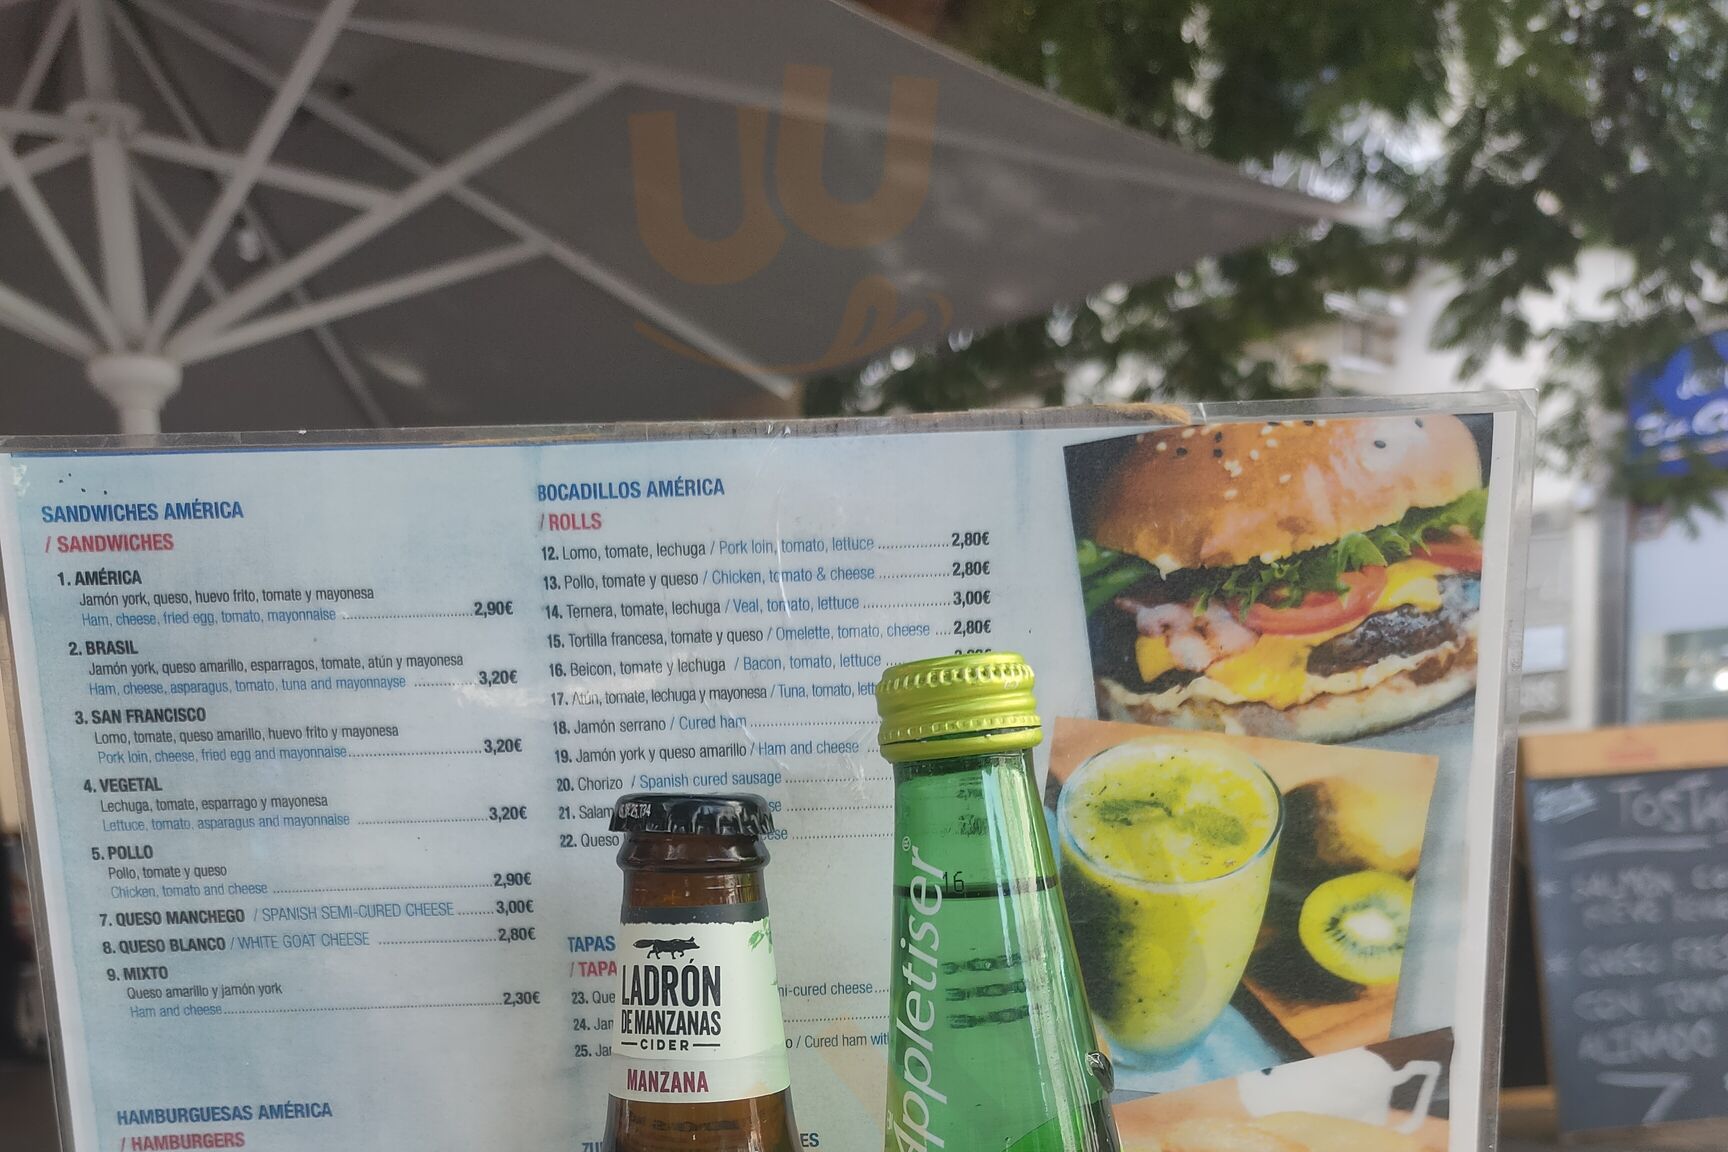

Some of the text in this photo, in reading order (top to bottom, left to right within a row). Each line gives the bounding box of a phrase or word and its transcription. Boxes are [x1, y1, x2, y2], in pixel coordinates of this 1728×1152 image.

[538, 476, 724, 502] BOCADILLOS AMÉRICA
[41, 499, 244, 523] SANDWICHES AMÉRICA
[549, 513, 602, 531] ROLLS
[57, 533, 174, 552] SANDWICHES
[542, 532, 990, 560] 12. Lomo, tomate, lechuga Pork loin, tomato, lettuce 2,80€
[75, 568, 142, 585] AMÉRICA
[544, 561, 990, 590] 13. Pollo, tomate queso Chicken, tomato cheese 2,80€
[80, 588, 374, 608] Jamón york, queso, huevo frito, tomate mayonesa
[546, 591, 991, 619] 14. Ternera, 3,00€
[474, 601, 513, 618] 2,90€
[548, 620, 991, 648] 15. Tortilla francesa, tomate queso Omelette, tomato, cheese 2,80€
[85, 641, 138, 655] BRASIL
[89, 683, 120, 696] Ham,
[123, 682, 167, 695] cheese,
[171, 682, 232, 695] asparagus,
[235, 680, 277, 692] tomato,
[282, 680, 307, 690] tuna
[311, 677, 332, 689] and
[479, 670, 518, 687] 3,20€
[551, 684, 808, 705] 17. Tuna,
[91, 710, 121, 724] SAN
[126, 707, 206, 723] FRANCISCO
[554, 715, 747, 734] 18. Jamón serrano Cured ham
[484, 739, 522, 755] 3,20€
[100, 778, 162, 792] VEGETAL
[557, 772, 781, 791] 20. Chorizo Spanish cured sausage
[489, 806, 527, 823] 3,20€
[559, 807, 575, 820] 21.
[579, 805, 613, 819] Salam
[560, 834, 619, 847] 22. Queso
[108, 845, 153, 860] POLLO
[494, 872, 531, 889] 2,90€
[116, 911, 162, 926] QUESO
[167, 909, 245, 924] MANCHEGO
[262, 906, 317, 922] SPANISH
[322, 903, 401, 919] SEMI-CURED
[406, 902, 454, 916] CHEESE
[496, 900, 534, 916] 3,00€
[120, 939, 164, 954] QUESO
[170, 937, 225, 951] BLANCO
[239, 935, 279, 949] WHITE
[283, 934, 316, 948] GOAT
[322, 932, 369, 947] CHEESE
[498, 928, 535, 943] 2,80€
[568, 936, 616, 952] TAPAS
[124, 966, 168, 980] MIXTO
[622, 959, 721, 1006] LADRÓN
[831, 982, 873, 995] cheese
[503, 992, 540, 1007] 2,30€
[572, 992, 588, 1004] 23.
[622, 1010, 632, 1034] DE
[635, 1010, 721, 1035] MANZANAS
[641, 1039, 689, 1050] CIDER
[805, 1032, 889, 1048] Cured ham wit
[628, 1069, 709, 1092] MANZANA
[117, 1101, 333, 1125] HAMBURGUESAS AMÉRICA
[132, 1132, 245, 1151] HAMBURGERS
